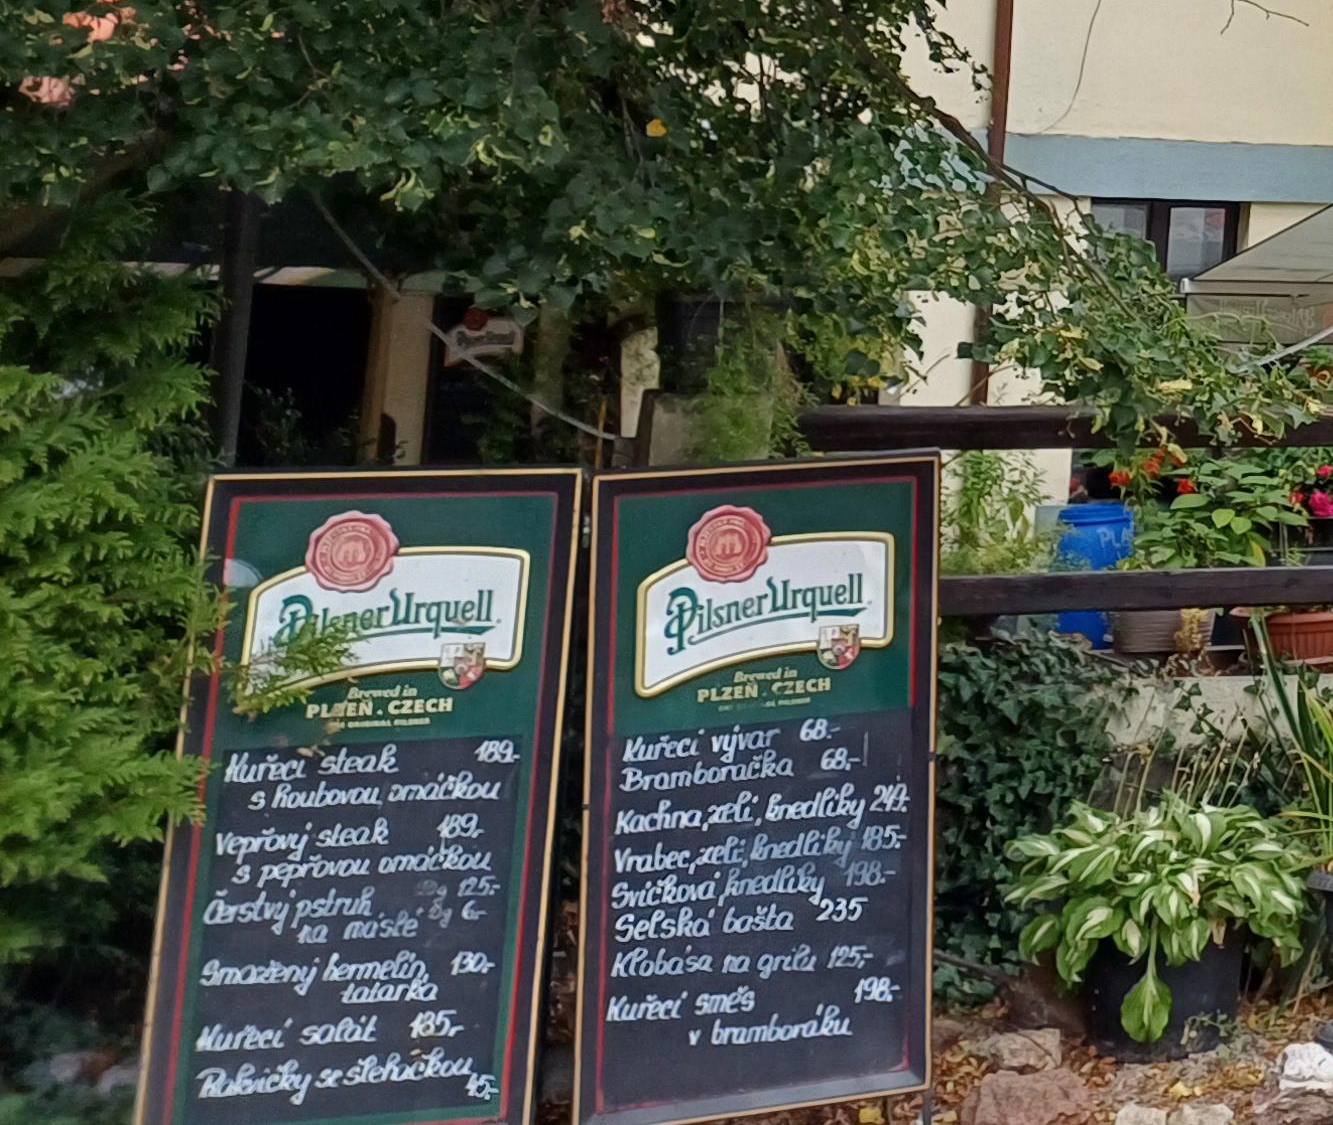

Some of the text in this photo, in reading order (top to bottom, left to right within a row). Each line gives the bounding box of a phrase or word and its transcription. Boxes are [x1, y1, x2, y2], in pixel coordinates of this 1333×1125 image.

[389, 587, 494, 639] Urquell
[664, 573, 865, 656] Pilsner Urquell
[387, 697, 454, 715] CZECH
[697, 677, 831, 703] PLZEŇ CZECH
[317, 743, 400, 775] steak
[711, 725, 781, 763] vývar
[618, 750, 794, 792] Bramboračka
[316, 818, 390, 847] steak
[291, 884, 375, 929] pstruh
[614, 897, 868, 943] Selská bašta 235
[298, 923, 328, 944] na
[611, 944, 713, 978] Klobása
[721, 954, 750, 974] na
[757, 944, 818, 979] grilu
[694, 985, 756, 1016] směs
[300, 1014, 378, 1045] salát
[687, 1003, 853, 1046] v bramboráku
